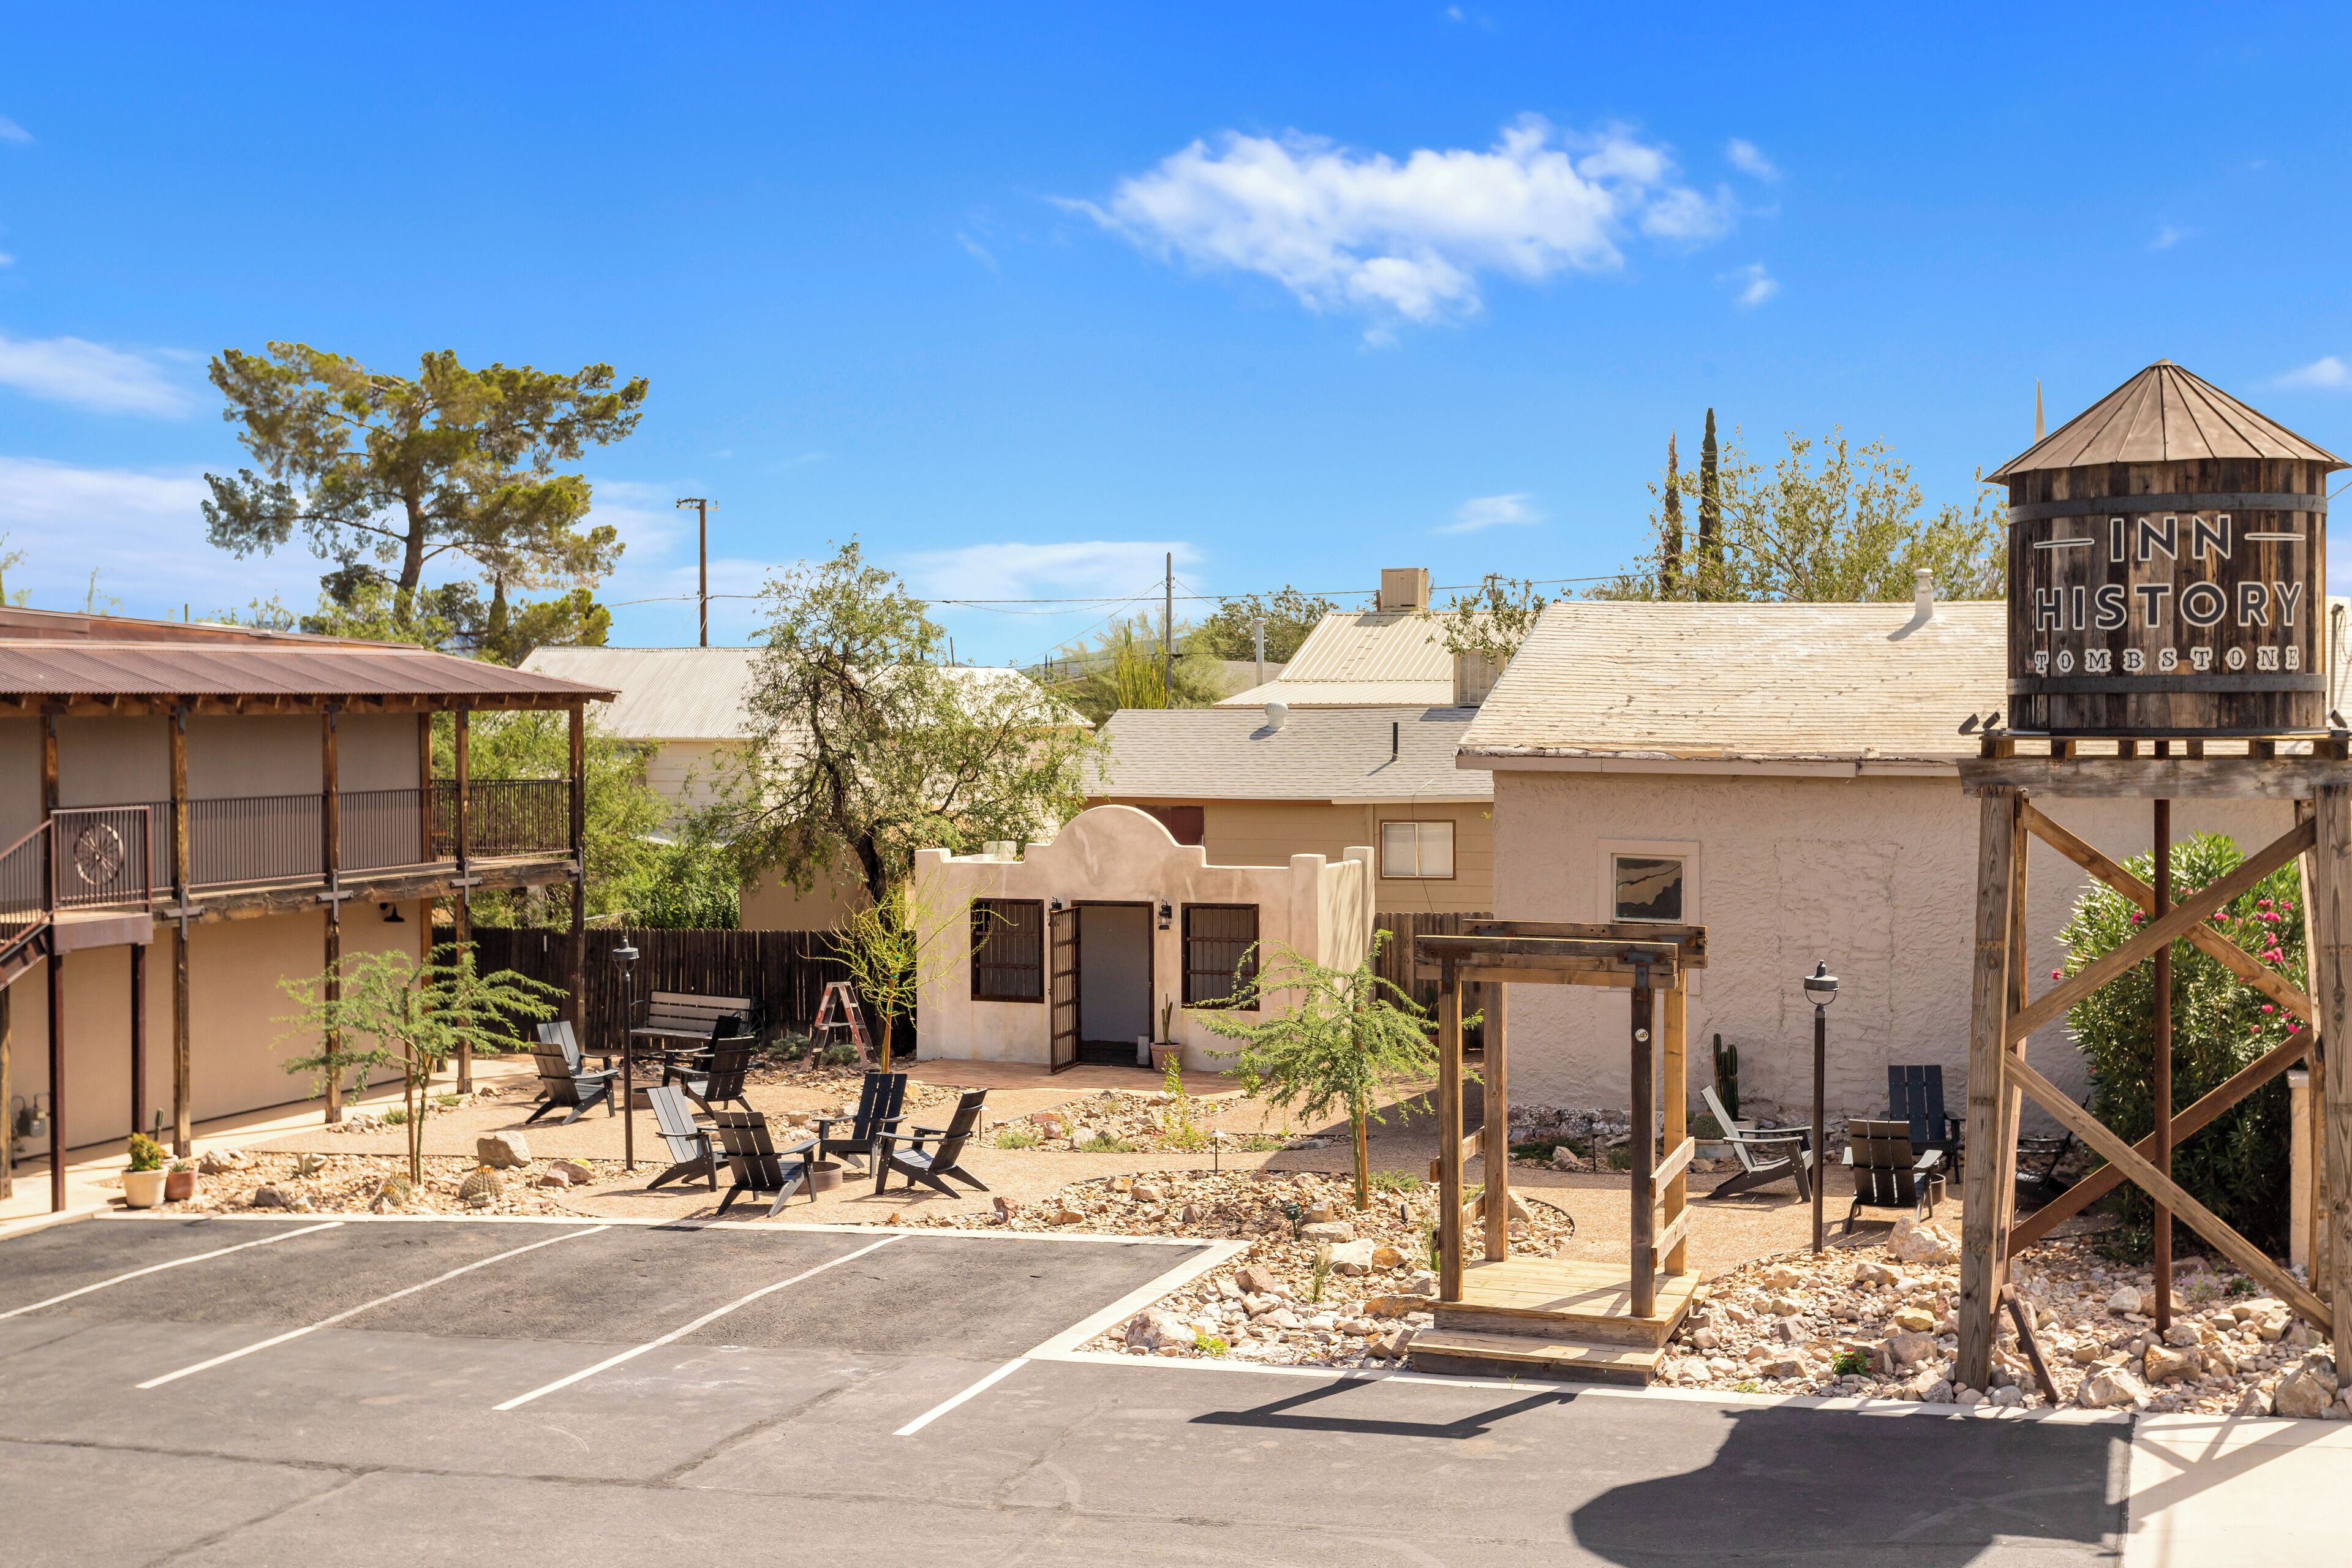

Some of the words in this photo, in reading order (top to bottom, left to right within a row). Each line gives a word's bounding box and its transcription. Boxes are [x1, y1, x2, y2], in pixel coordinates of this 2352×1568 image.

[2110, 514, 2231, 562] INN
[2036, 581, 2302, 631] HISTORY
[2035, 645, 2299, 673] TOMBSTONE
